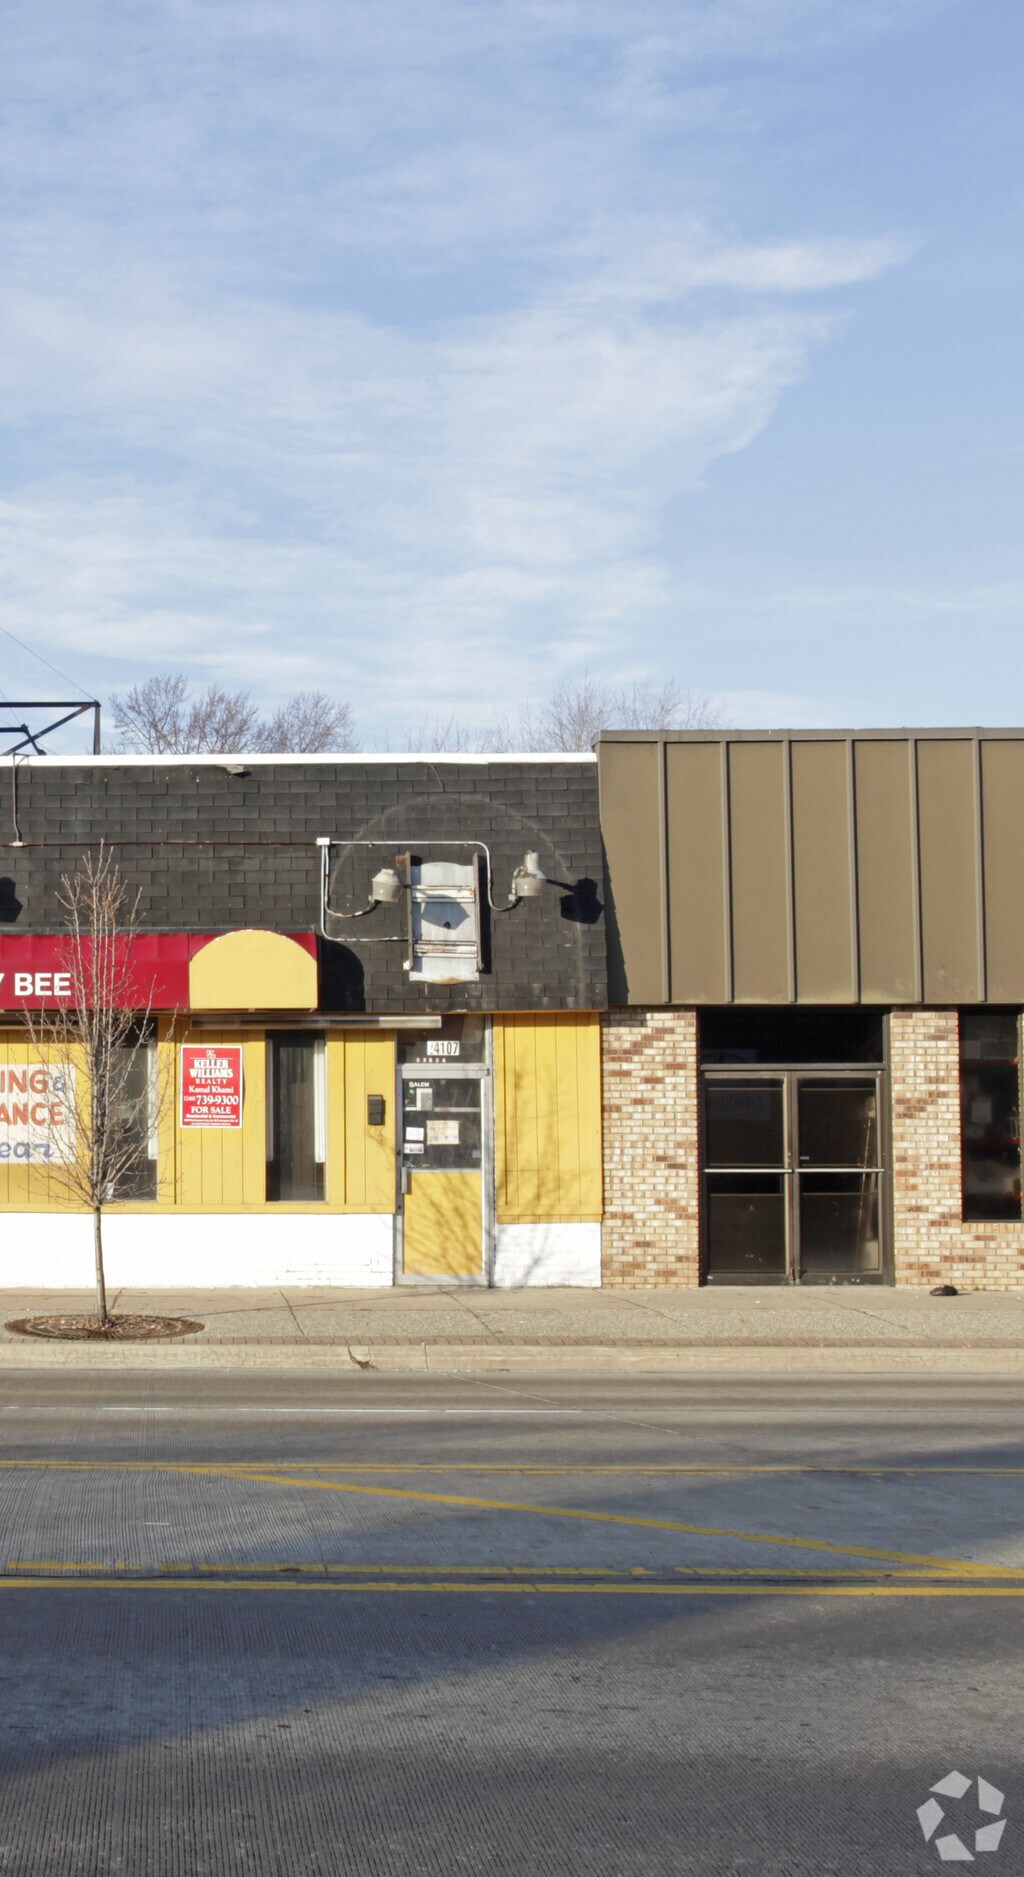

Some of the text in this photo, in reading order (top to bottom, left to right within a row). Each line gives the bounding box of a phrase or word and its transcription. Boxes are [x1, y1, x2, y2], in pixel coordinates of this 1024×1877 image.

[14, 972, 72, 997] BEE
[194, 1060, 229, 1068] KELLER
[189, 1068, 234, 1078] WILLIAMS
[52, 1075, 67, 1093] &
[189, 1085, 210, 1093] Kamal
[196, 1095, 239, 1105] 739-9300
[191, 1106, 232, 1114] FOR SALE
